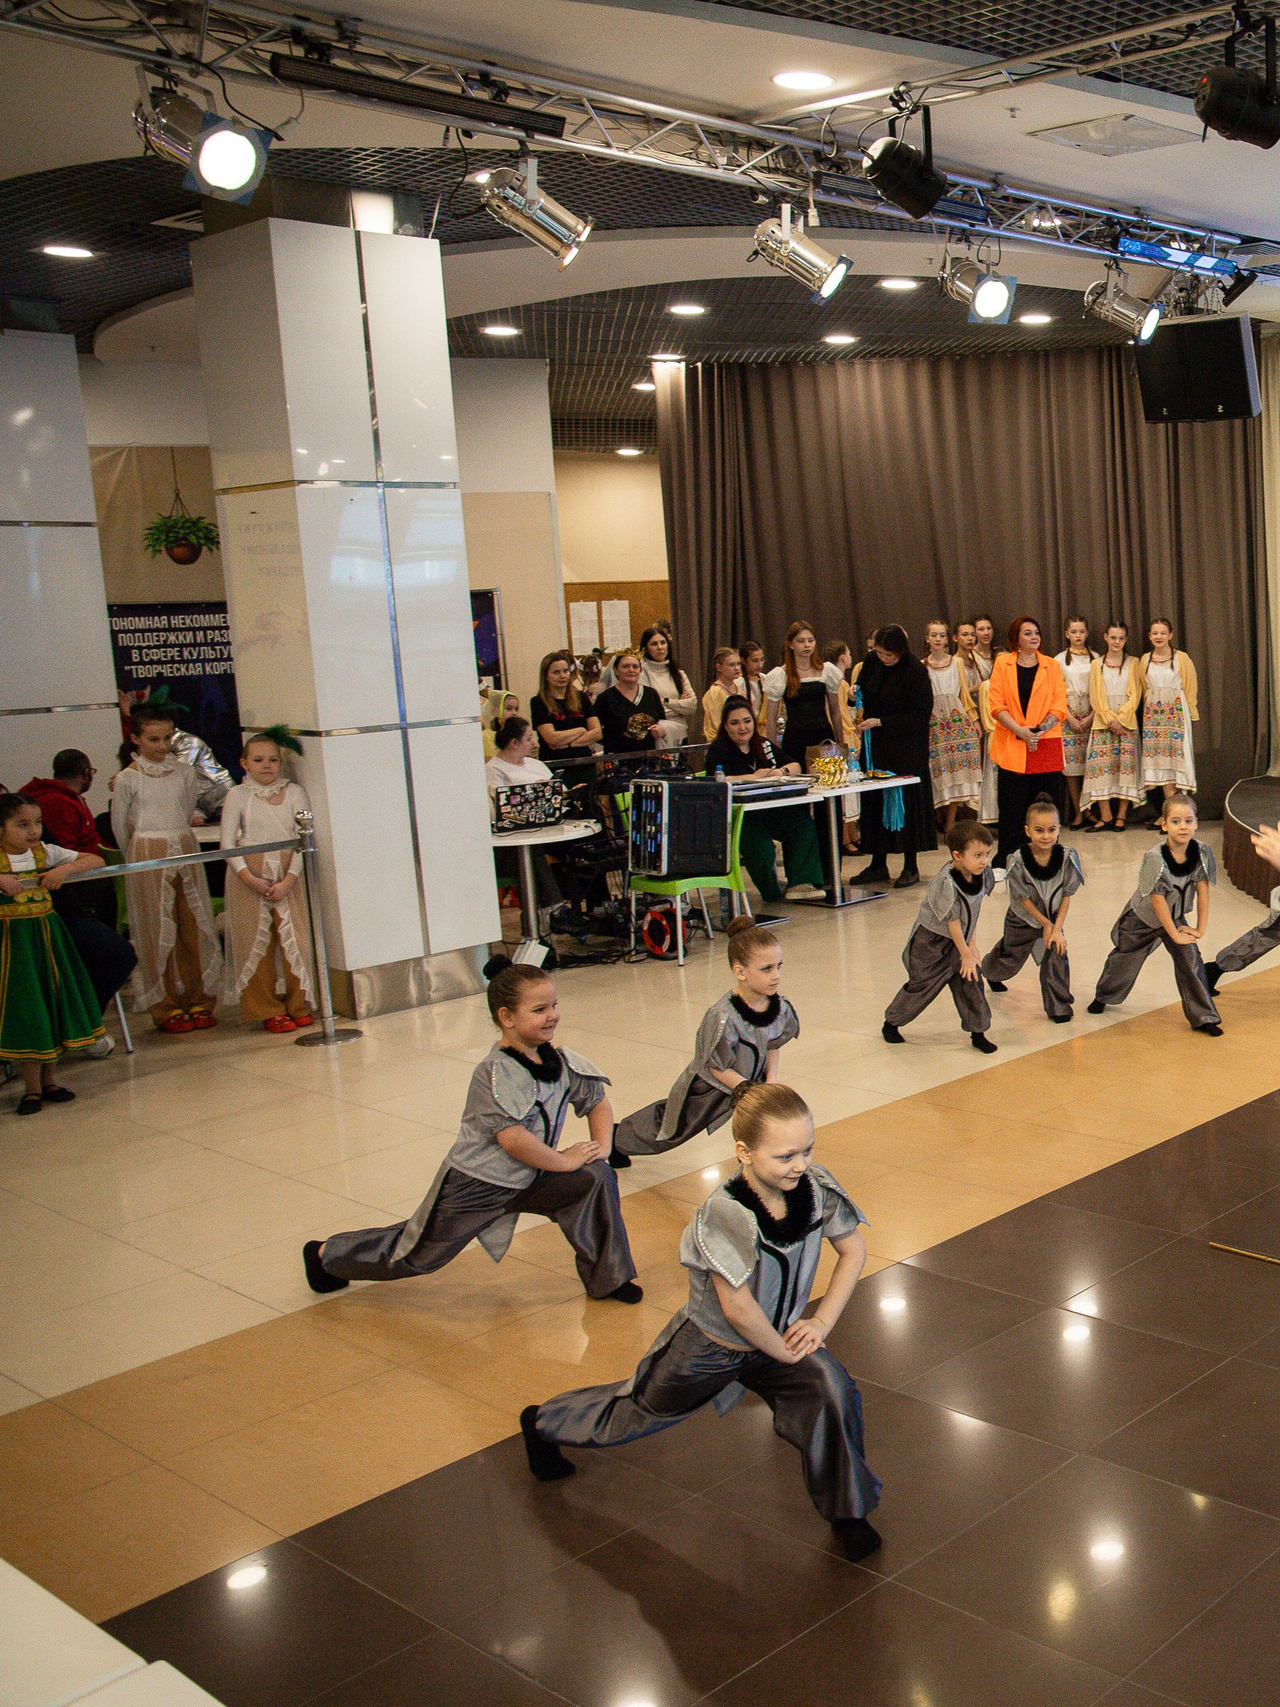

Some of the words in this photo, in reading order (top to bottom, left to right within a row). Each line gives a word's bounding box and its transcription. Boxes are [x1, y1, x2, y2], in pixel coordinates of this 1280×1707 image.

[171, 613, 229, 628] НЕКОММЕ
[118, 632, 194, 646] ПОДДЕРЖКИ
[196, 631, 205, 643] И
[206, 630, 231, 643] РАЗ
[131, 649, 140, 662] В
[142, 647, 181, 662] СФЕРЕ
[124, 662, 203, 678] "ТВОРЧЕСКАЯ
